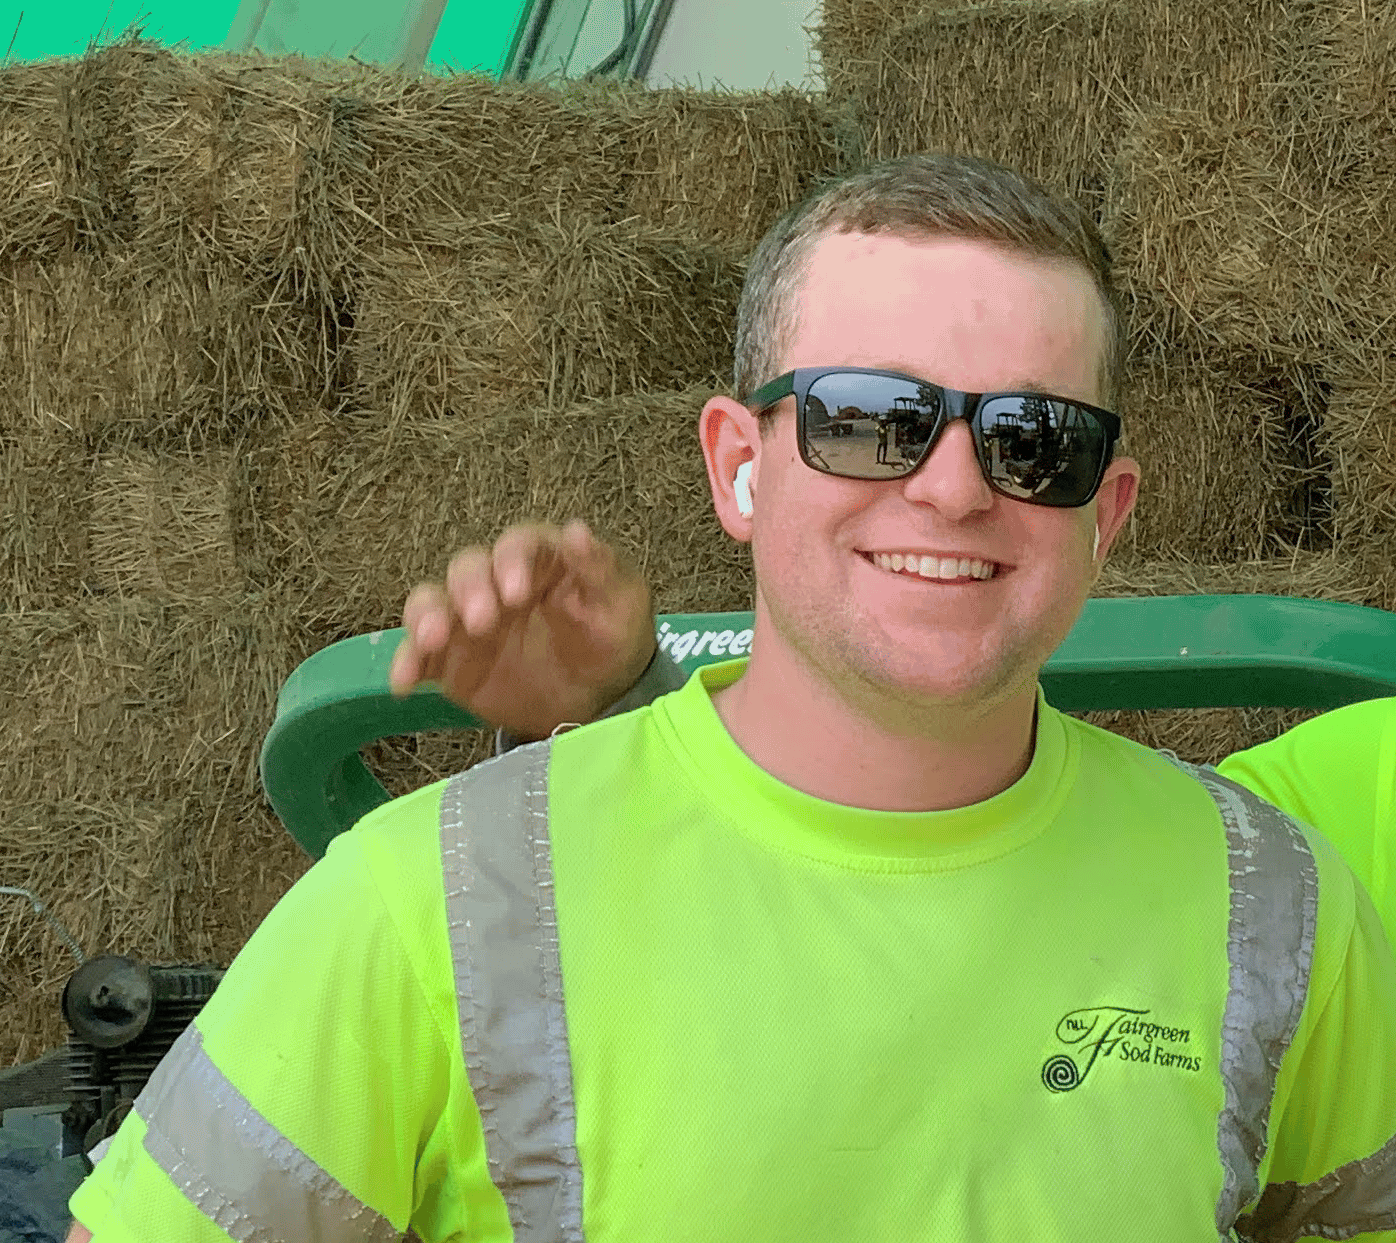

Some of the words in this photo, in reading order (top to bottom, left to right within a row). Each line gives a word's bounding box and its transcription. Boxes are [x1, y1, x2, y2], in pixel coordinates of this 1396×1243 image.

[656, 622, 754, 664] irgree
[1042, 1006, 1190, 1093] Fairgreen
[1119, 1041, 1152, 1063] Sod
[1154, 1046, 1201, 1071] Farms
